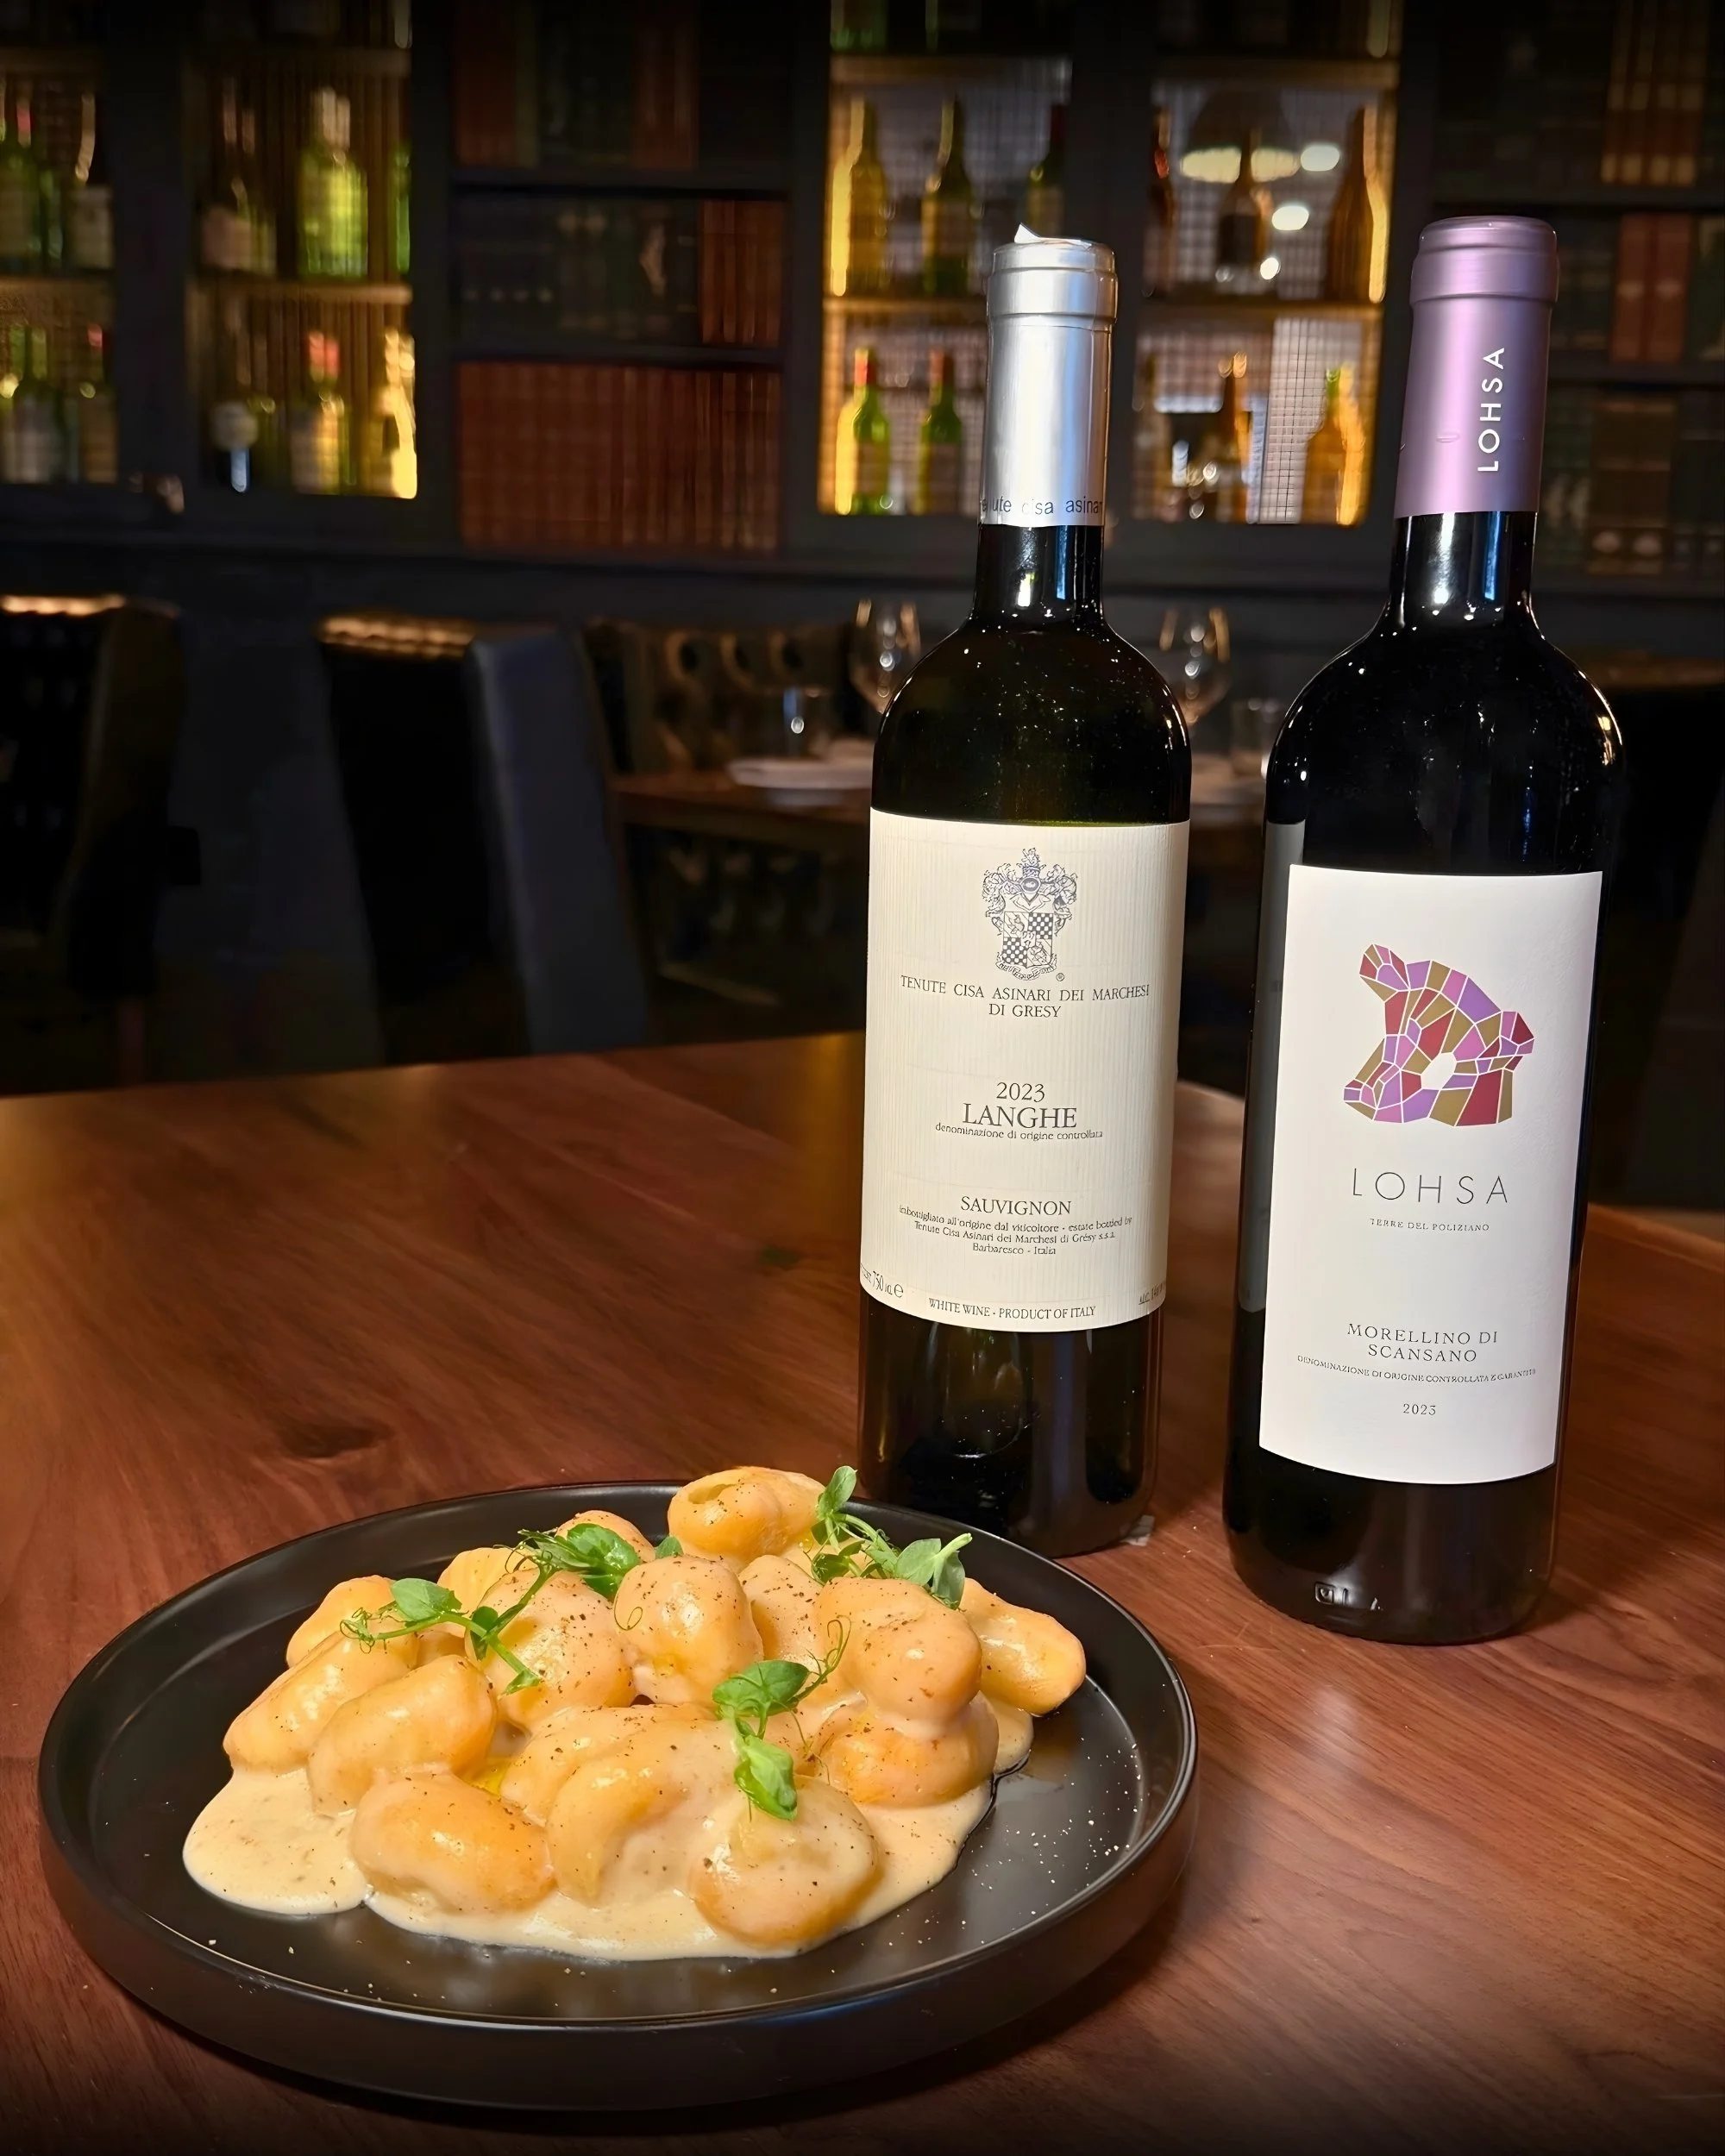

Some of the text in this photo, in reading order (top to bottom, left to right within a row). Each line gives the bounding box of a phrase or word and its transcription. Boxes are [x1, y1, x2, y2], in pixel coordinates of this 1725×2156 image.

[1477, 348, 1505, 472] LOHSA
[900, 975, 1150, 1001] TENUTE CISA ASINARI DEI MARCHESI
[988, 1003, 1062, 1018] DI GRESY
[996, 1081, 1045, 1103] 2023
[963, 1102, 1077, 1129] LANGHE
[935, 1122, 1004, 1138] denominazione
[1007, 1130, 1017, 1139] di
[1019, 1131, 1054, 1142] origine
[1352, 1168, 1508, 1205] LOHSA
[960, 1195, 1071, 1216] SAUVIGNON
[914, 1220, 940, 1234] Tenute
[942, 1226, 960, 1238] Cisa
[963, 1231, 994, 1242] Asinari
[996, 1234, 1012, 1243] dei
[1015, 1234, 1057, 1244] Marchesi
[1060, 1234, 1070, 1243] di
[994, 1221, 1008, 1232] dal
[1370, 1218, 1490, 1232] TERRE DEL POLIZIANO
[973, 1242, 1024, 1255] Barbaresco
[1033, 1246, 1056, 1255] Italia
[928, 1297, 960, 1313] WHITE
[963, 1304, 991, 1317] WINE
[999, 1307, 1051, 1319] PRODUCT
[1053, 1307, 1068, 1319] OF
[1070, 1306, 1095, 1319] ITALY
[1347, 1323, 1497, 1344] MORELLINO DI
[1368, 1344, 1477, 1362] SCANSANO
[1297, 1355, 1370, 1376] DENOMINAZIONE
[1383, 1371, 1424, 1382] ORIGINE
[1426, 1375, 1489, 1383] CONTROLLATA
[1402, 1403, 1437, 1416] 2023
